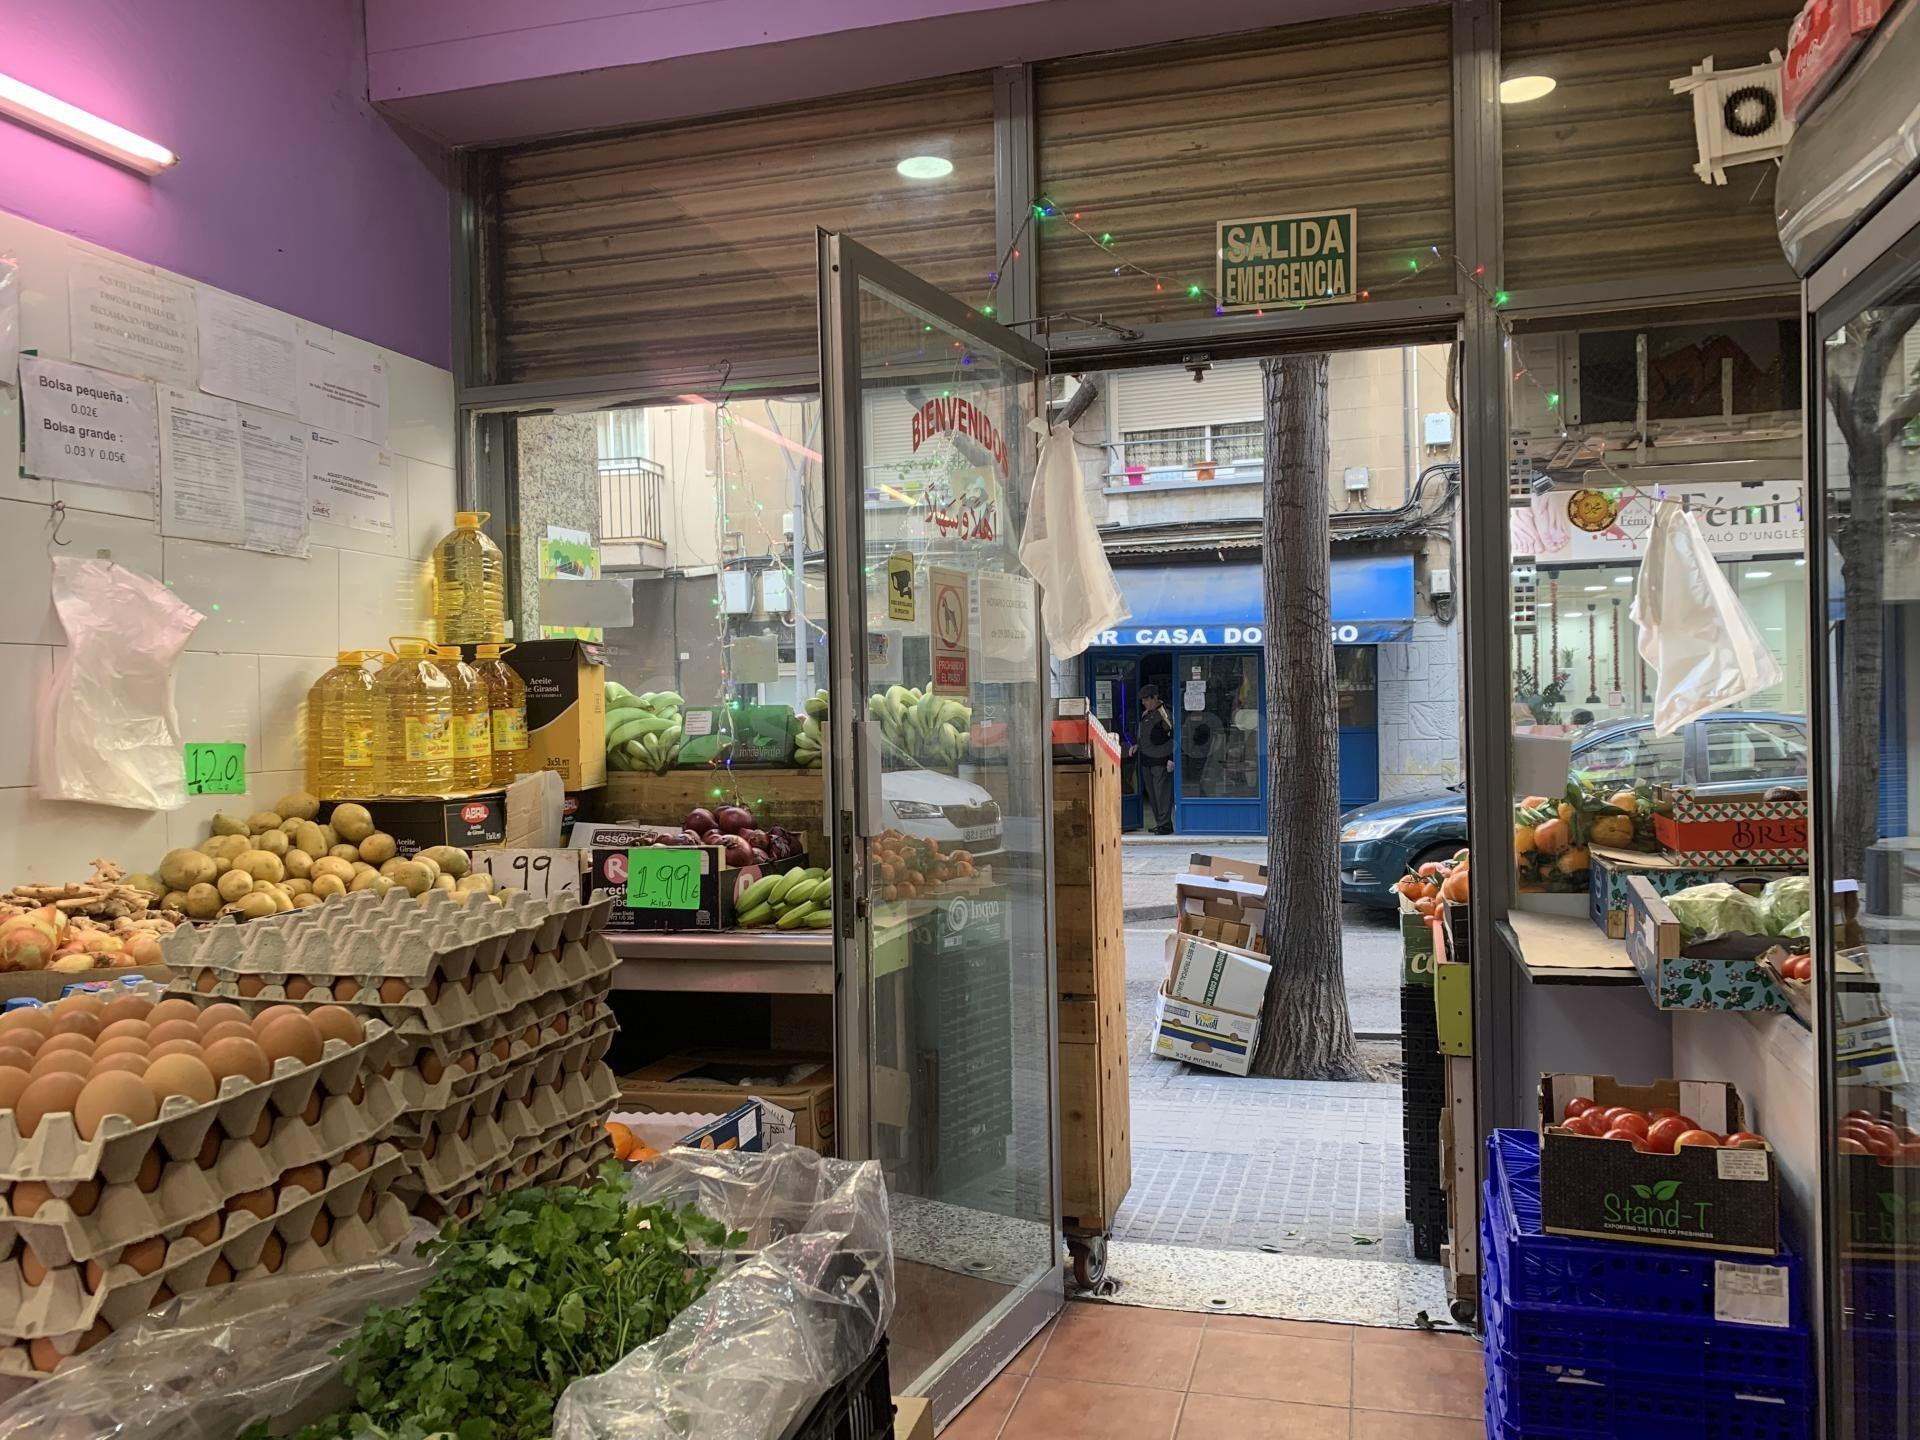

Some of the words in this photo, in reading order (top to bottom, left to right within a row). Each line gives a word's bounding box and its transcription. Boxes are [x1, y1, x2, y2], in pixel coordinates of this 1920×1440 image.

[1227, 218, 1345, 263] SALIDA
[1226, 259, 1346, 304] EMERGENCIA
[39, 375, 73, 392] Bolsa
[76, 384, 123, 403] pequeña
[70, 403, 99, 418] 0.02€
[43, 418, 75, 434] Bolsa
[78, 427, 117, 442] grande
[912, 396, 1009, 478] BIENVENIDOS
[64, 444, 86, 457] 0.03
[88, 447, 95, 458] Y
[99, 449, 126, 463] 0.05€
[1135, 629, 1207, 644] CASA
[530, 677, 552, 685] Aceite
[533, 685, 560, 693] Girasol
[465, 806, 488, 820] ABRIL
[396, 838, 416, 846] Aceite
[1174, 1051, 1192, 1060] PACK
[1192, 1056, 1223, 1069] PREMIUM
[1603, 1192, 1713, 1231] Stand-T
[1603, 1222, 1637, 1232] EXPORTING
[1638, 1225, 1649, 1233] THE
[1650, 1227, 1667, 1235] TASTE
